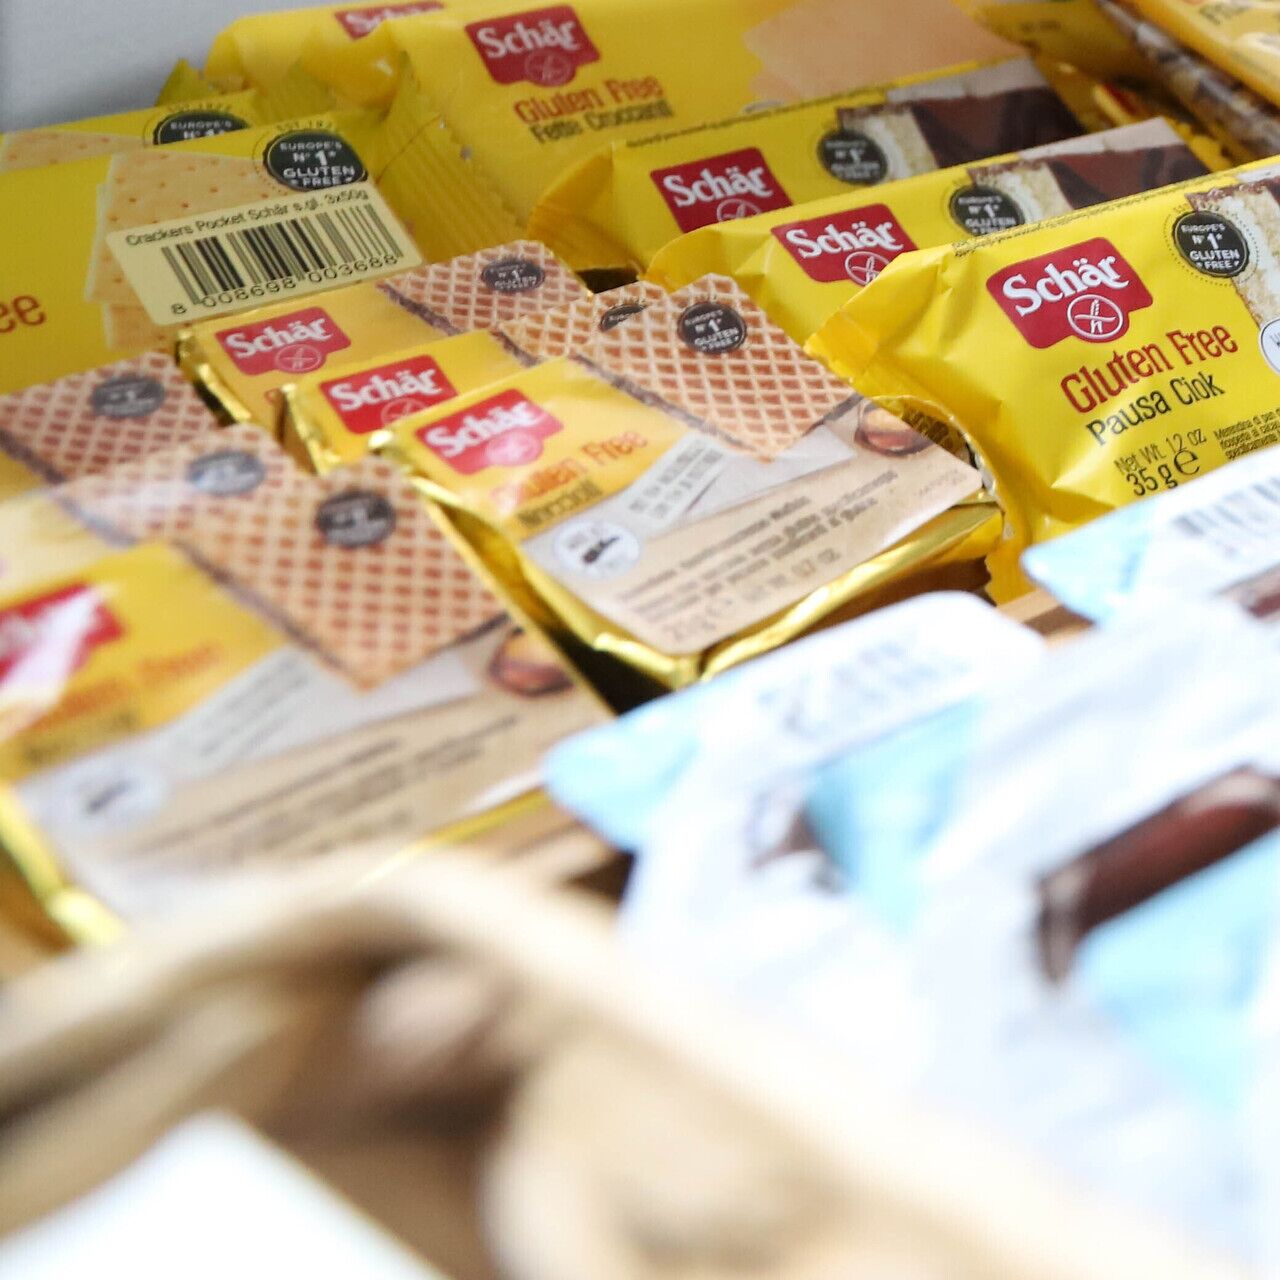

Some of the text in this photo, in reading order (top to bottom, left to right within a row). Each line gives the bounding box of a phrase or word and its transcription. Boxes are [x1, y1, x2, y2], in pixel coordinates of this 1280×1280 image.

[476, 19, 582, 60] Schär
[513, 86, 604, 124] Gluten
[605, 75, 665, 103] Free
[283, 165, 355, 179] GLUTEN
[302, 176, 341, 187] FREE
[663, 165, 774, 208] Schär
[125, 223, 194, 247] Crackers
[195, 212, 245, 232] Pocket
[785, 220, 905, 259] Schär
[964, 217, 1016, 228] GLUTEN
[1181, 223, 1226, 233] EUROPE'S
[1189, 249, 1240, 261] GLUTEN
[1204, 261, 1233, 270] FREE
[171, 255, 398, 316] 8 008698 003688
[1002, 255, 1130, 317] Schär
[224, 316, 334, 359] Schär
[329, 367, 444, 412] Schär
[1060, 325, 1239, 414] Gluten Free
[424, 401, 545, 457] Schär
[1086, 371, 1226, 446] Pausa Ciok
[1113, 454, 1141, 475] Net
[1187, 428, 1207, 446] oz
[1126, 466, 1158, 496] 35
[1157, 464, 1178, 489] g
